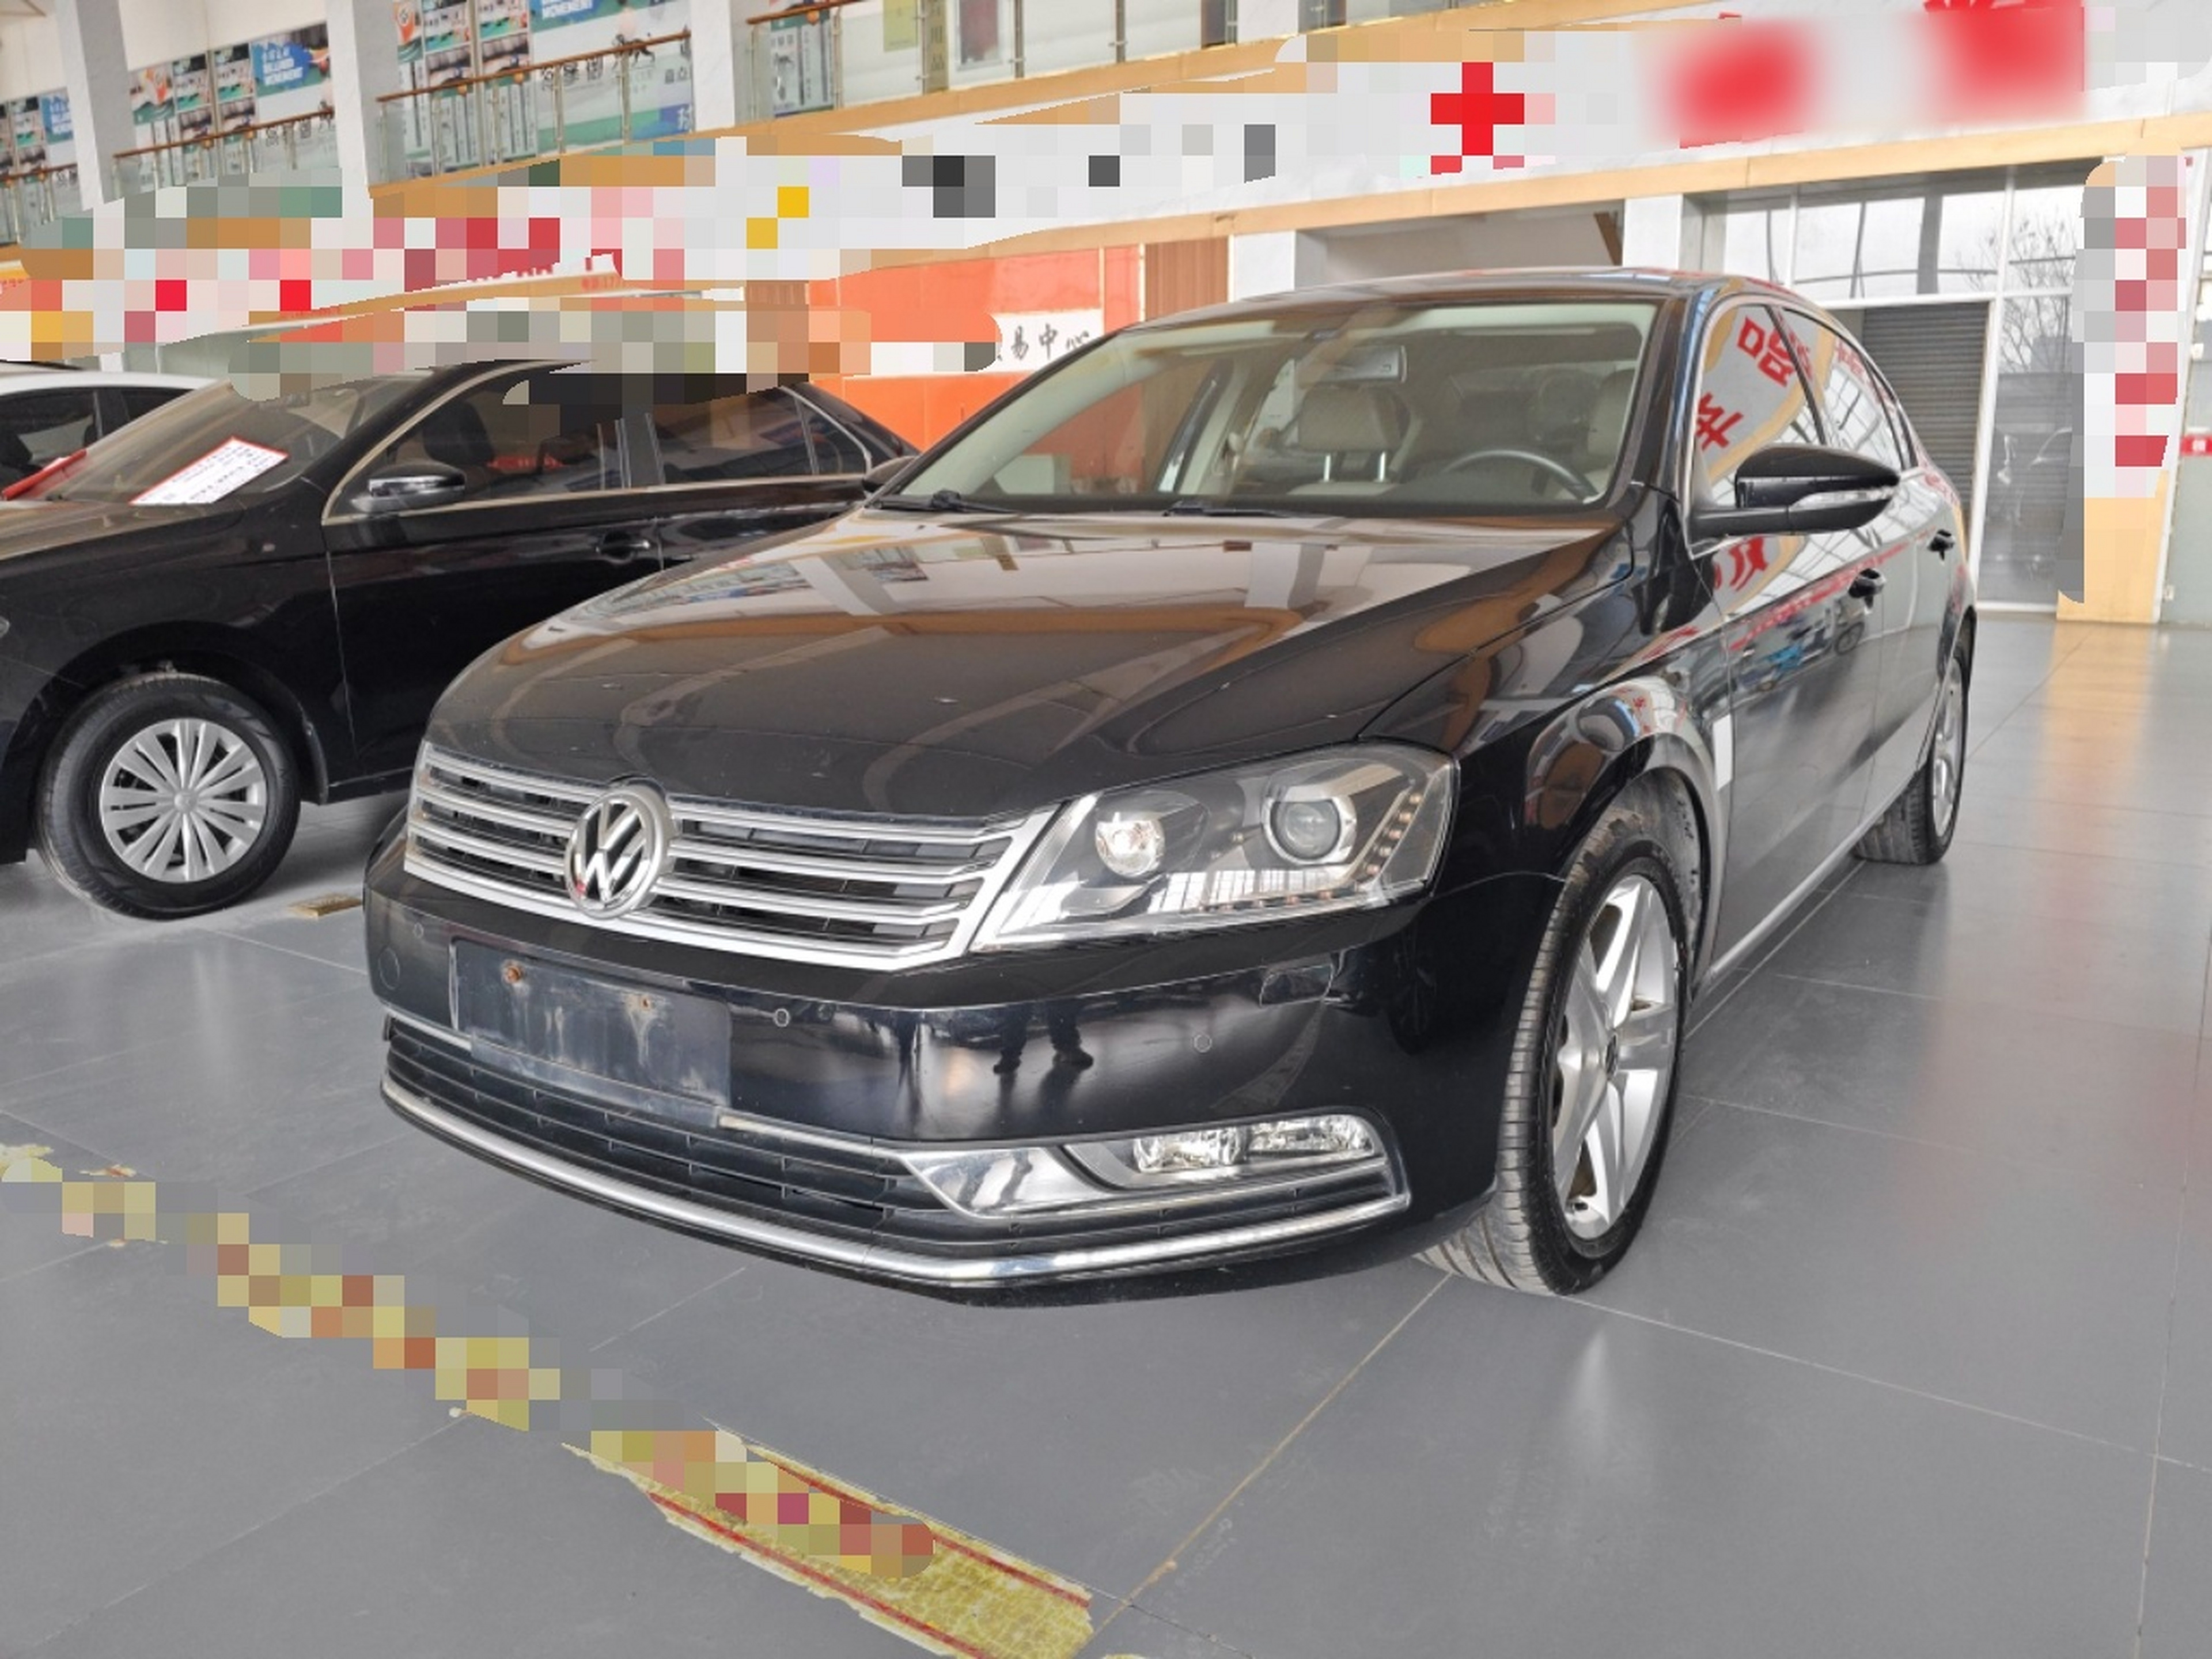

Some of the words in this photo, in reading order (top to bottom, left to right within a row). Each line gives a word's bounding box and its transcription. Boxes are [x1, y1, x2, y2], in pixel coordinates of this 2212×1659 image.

[997, 323, 1090, 361] 易中心
[573, 796, 656, 910] VW
